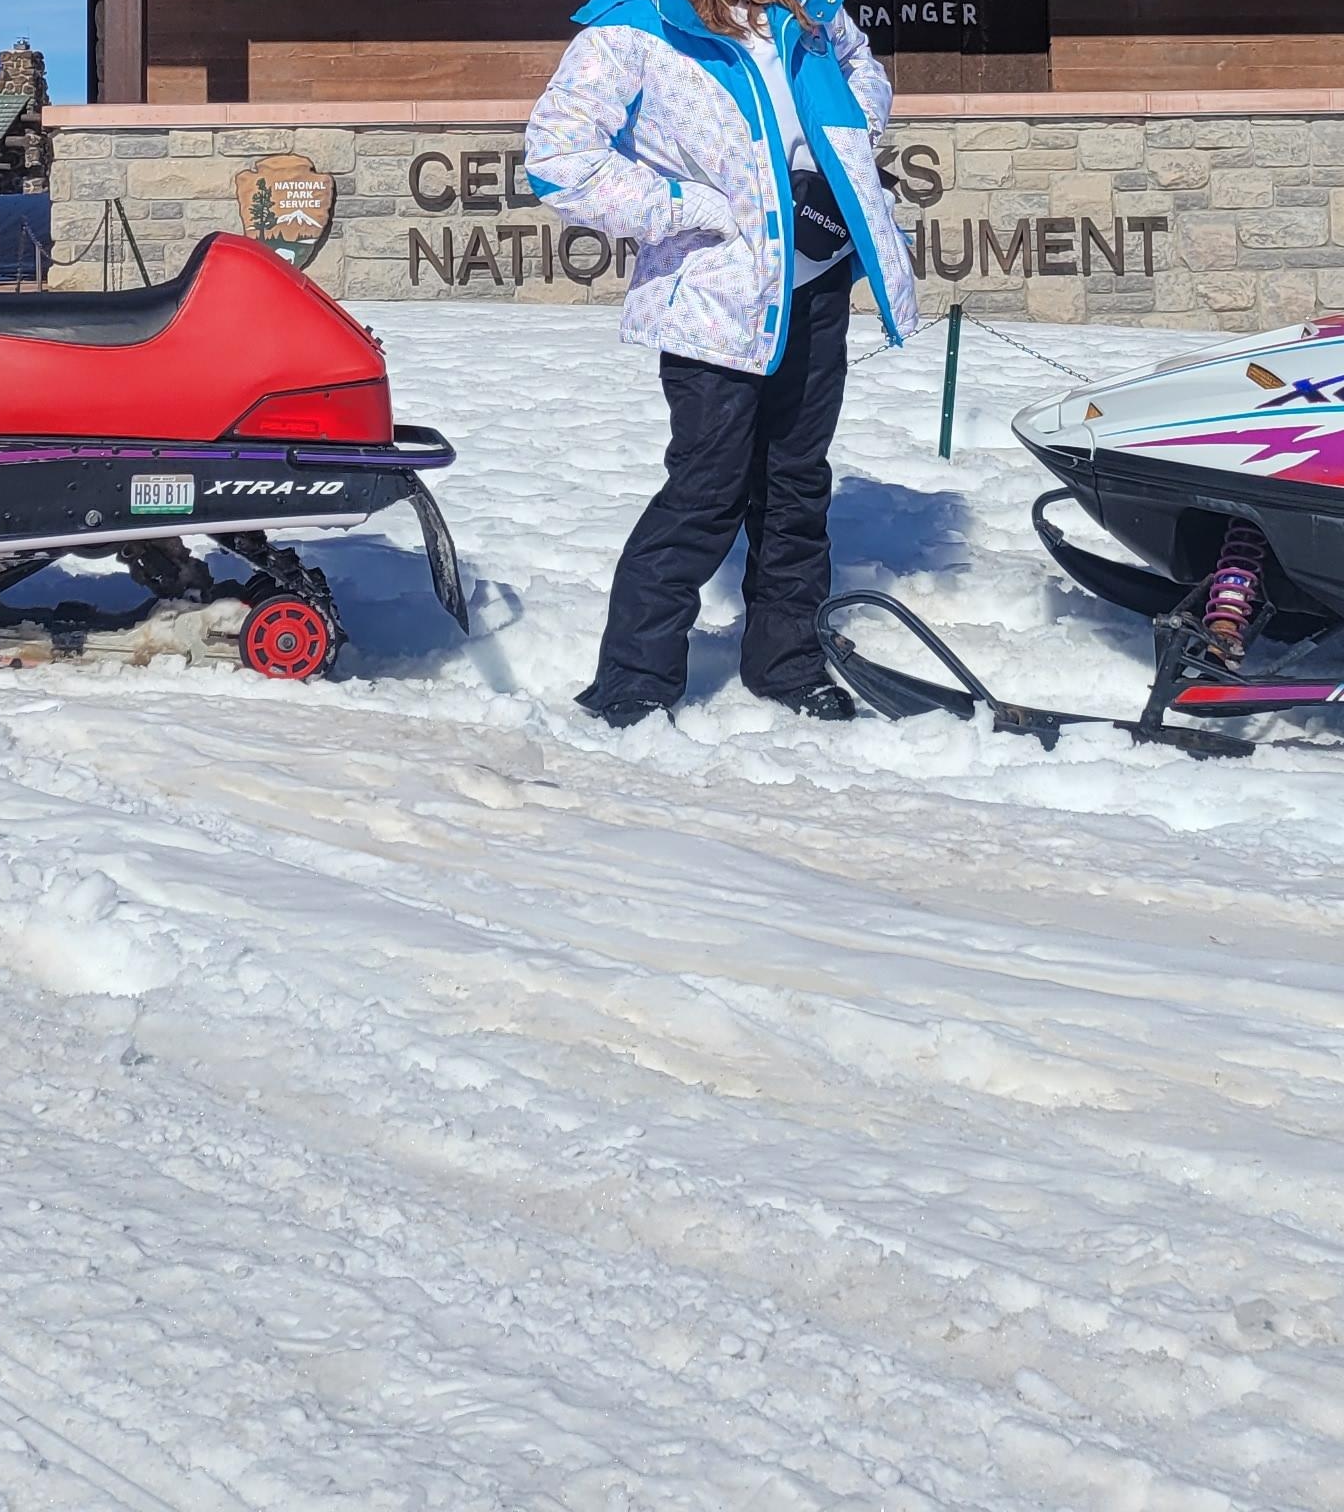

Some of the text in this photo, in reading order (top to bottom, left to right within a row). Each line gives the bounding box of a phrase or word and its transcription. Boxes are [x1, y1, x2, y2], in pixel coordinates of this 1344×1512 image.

[859, 2, 977, 28] RANGER
[274, 181, 326, 191] NATIONAL
[286, 190, 314, 200] PARK
[279, 199, 321, 209] SERVICE
[800, 205, 847, 239] pure barre
[409, 224, 637, 286] NATION
[134, 483, 189, 505] HB9 B11
[203, 480, 345, 496] XTRA-10
